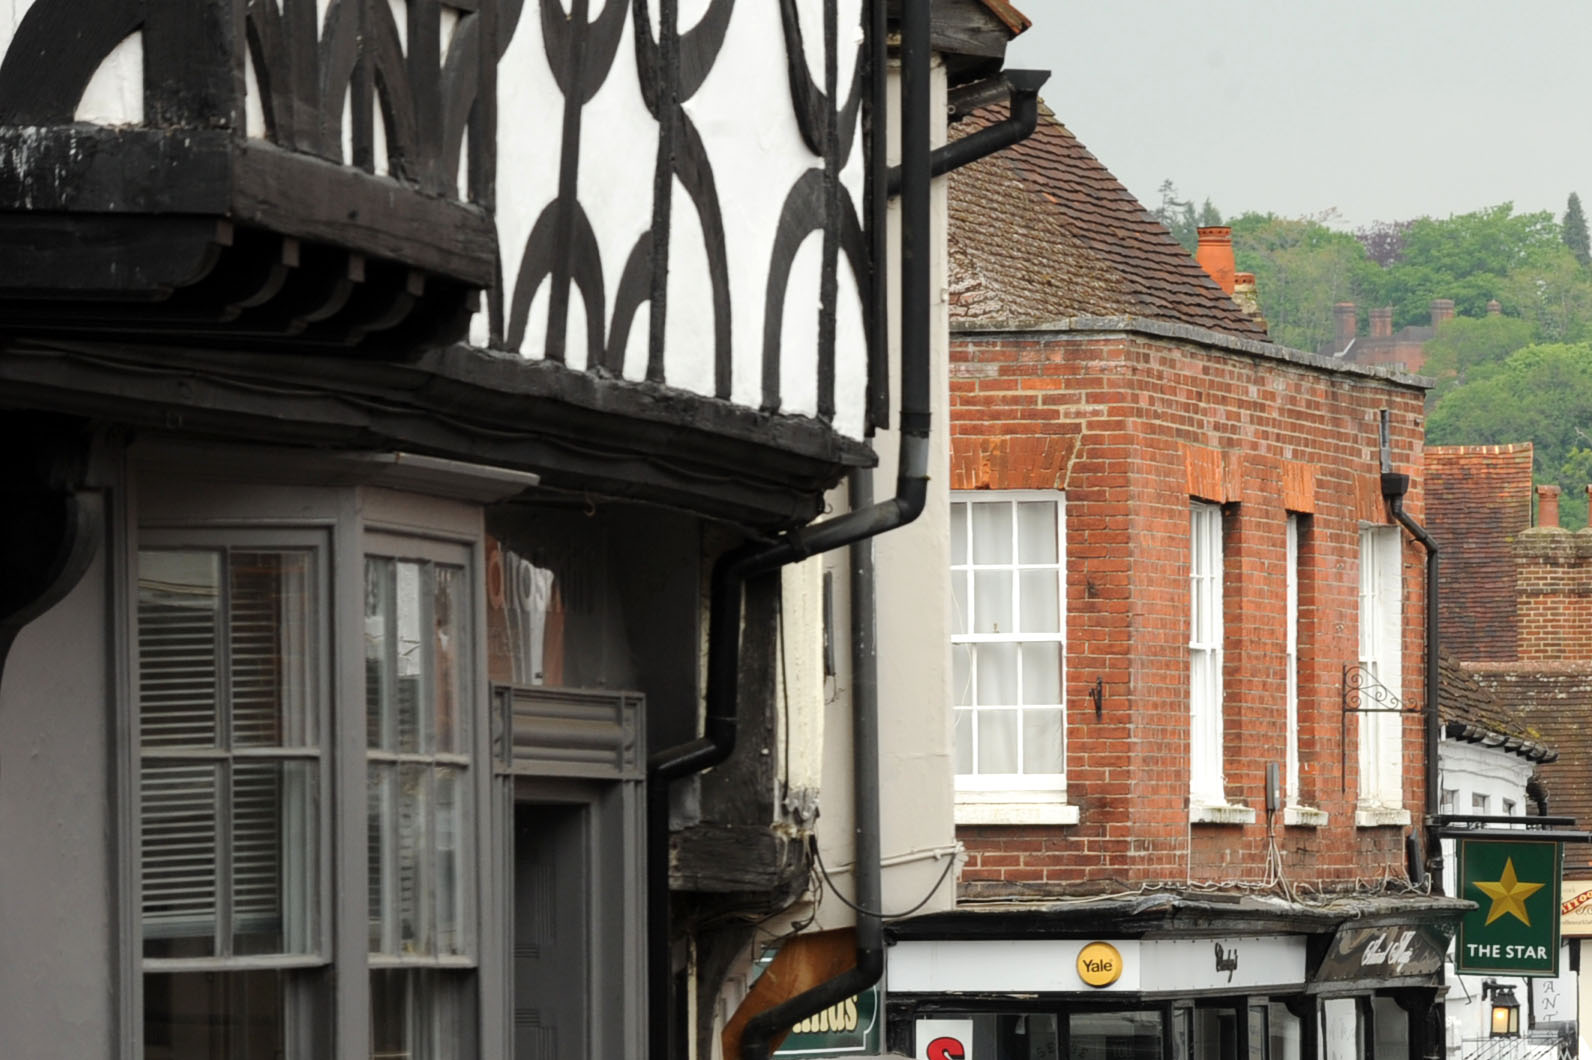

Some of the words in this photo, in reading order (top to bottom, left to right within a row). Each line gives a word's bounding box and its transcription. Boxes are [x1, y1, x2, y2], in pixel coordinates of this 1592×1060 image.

[1466, 943, 1501, 959] THE
[1505, 944, 1548, 960] STAR
[1082, 959, 1113, 973] Yale
